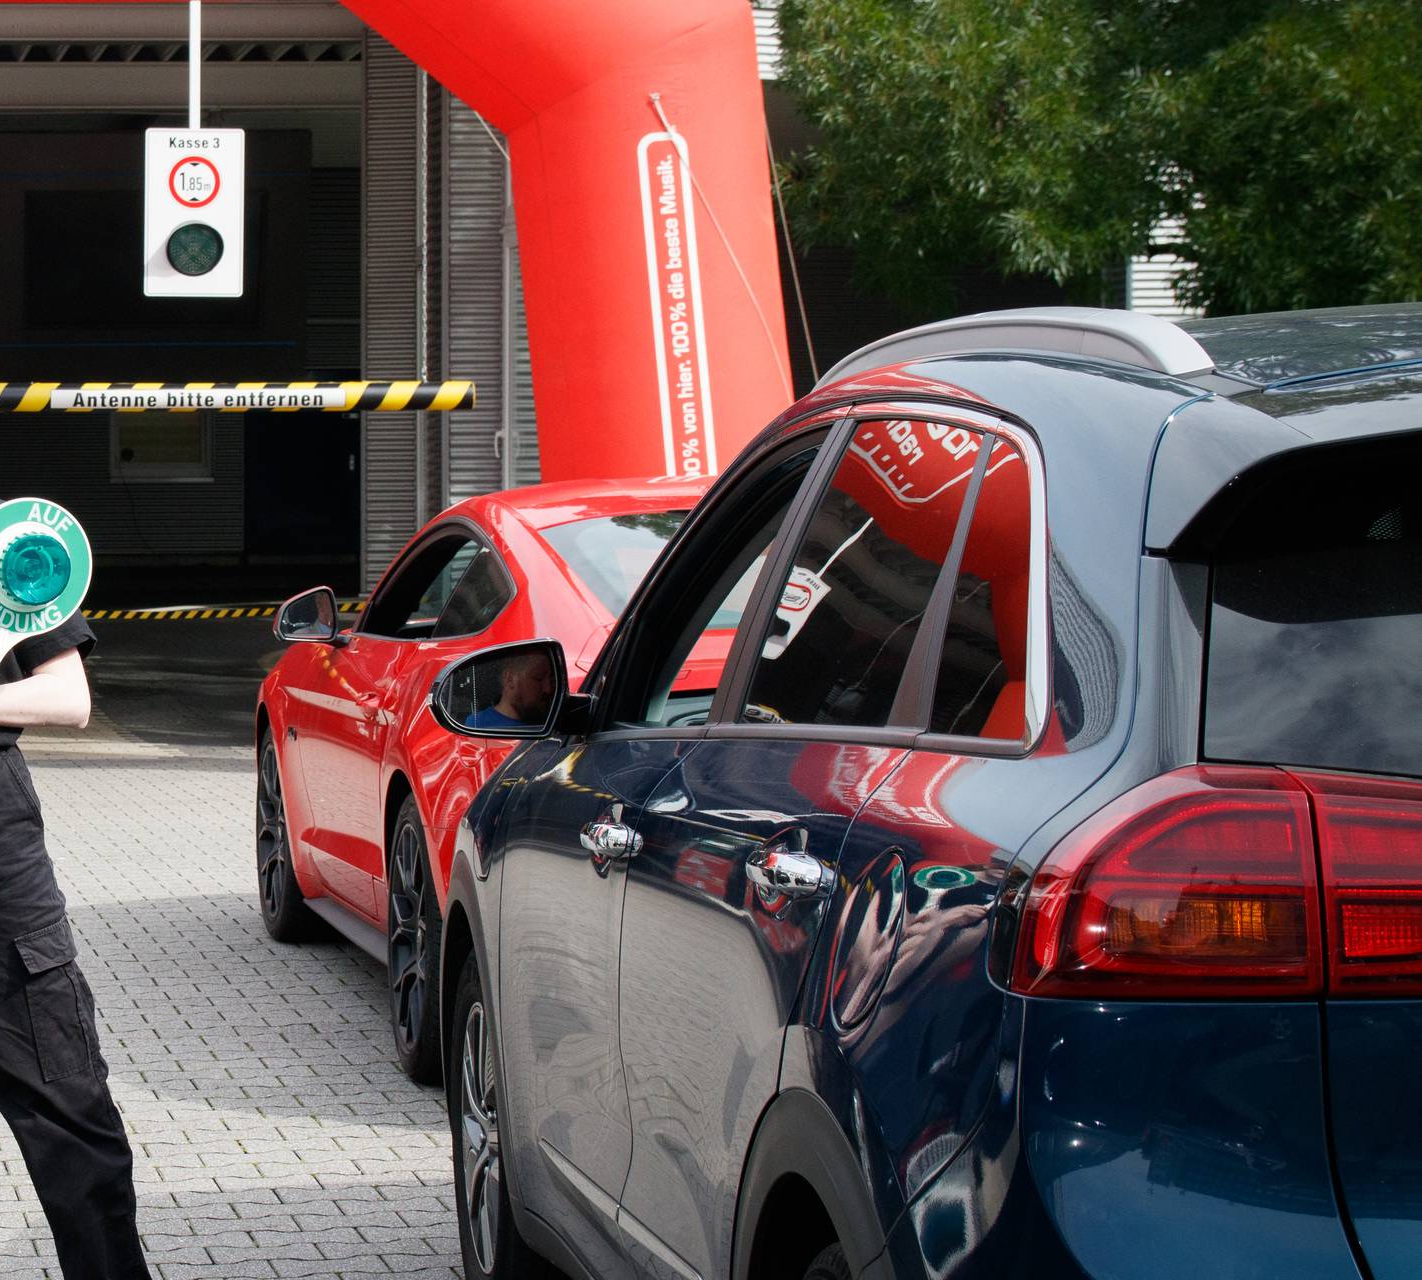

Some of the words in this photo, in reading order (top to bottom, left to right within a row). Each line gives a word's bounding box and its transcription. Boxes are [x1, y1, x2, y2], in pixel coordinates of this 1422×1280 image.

[169, 137, 209, 148] Kasse
[213, 137, 220, 148] 3
[656, 154, 678, 215] Musik.
[664, 218, 683, 269] beste
[667, 272, 685, 299] die
[669, 302, 690, 358] 100%
[676, 359, 694, 399] hier.
[73, 392, 157, 407] Antenne
[166, 391, 215, 407] bitte
[224, 391, 324, 407] entfernen
[682, 402, 698, 435] von
[27, 502, 74, 532] AUF
